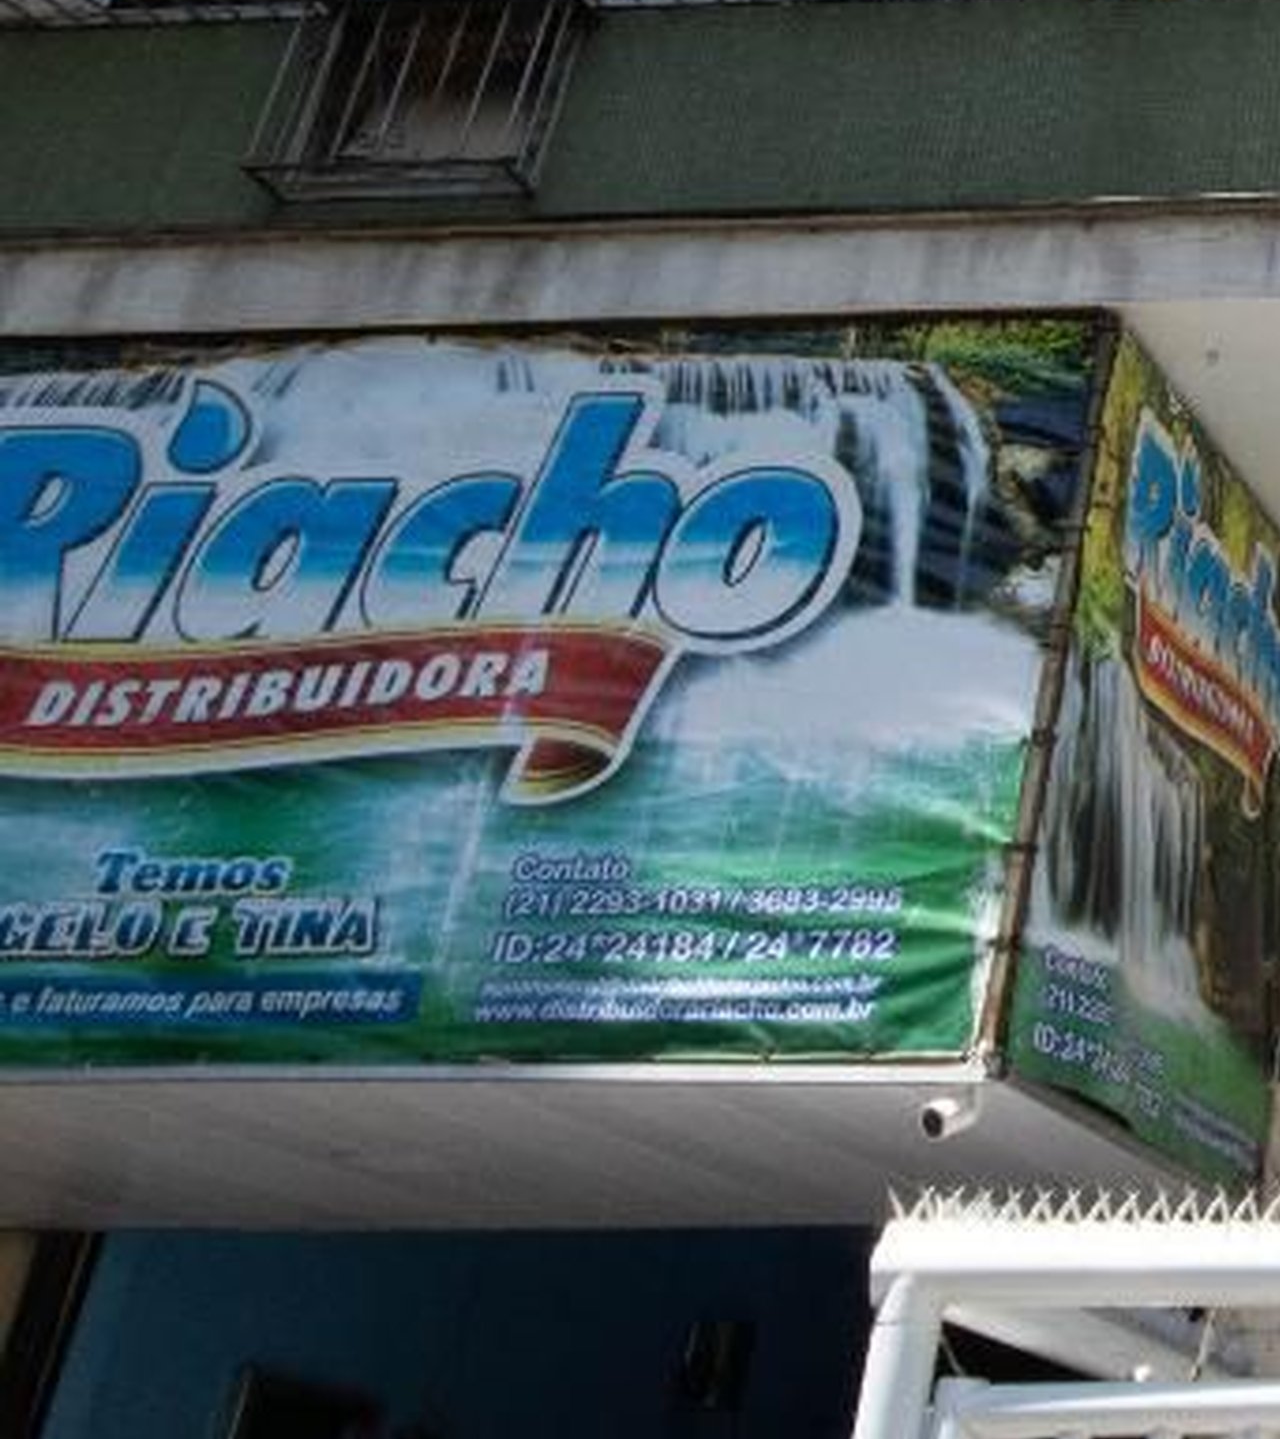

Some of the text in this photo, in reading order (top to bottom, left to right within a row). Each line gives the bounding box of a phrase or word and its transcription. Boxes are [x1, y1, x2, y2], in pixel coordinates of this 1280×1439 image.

[26, 650, 552, 728] DISTRIBUIDORA
[95, 848, 291, 895] Temos
[169, 908, 217, 956] E
[233, 901, 380, 956] TINA
[36, 985, 184, 1014] faturamos
[184, 990, 255, 1020] para
[260, 988, 402, 1021] empresas
